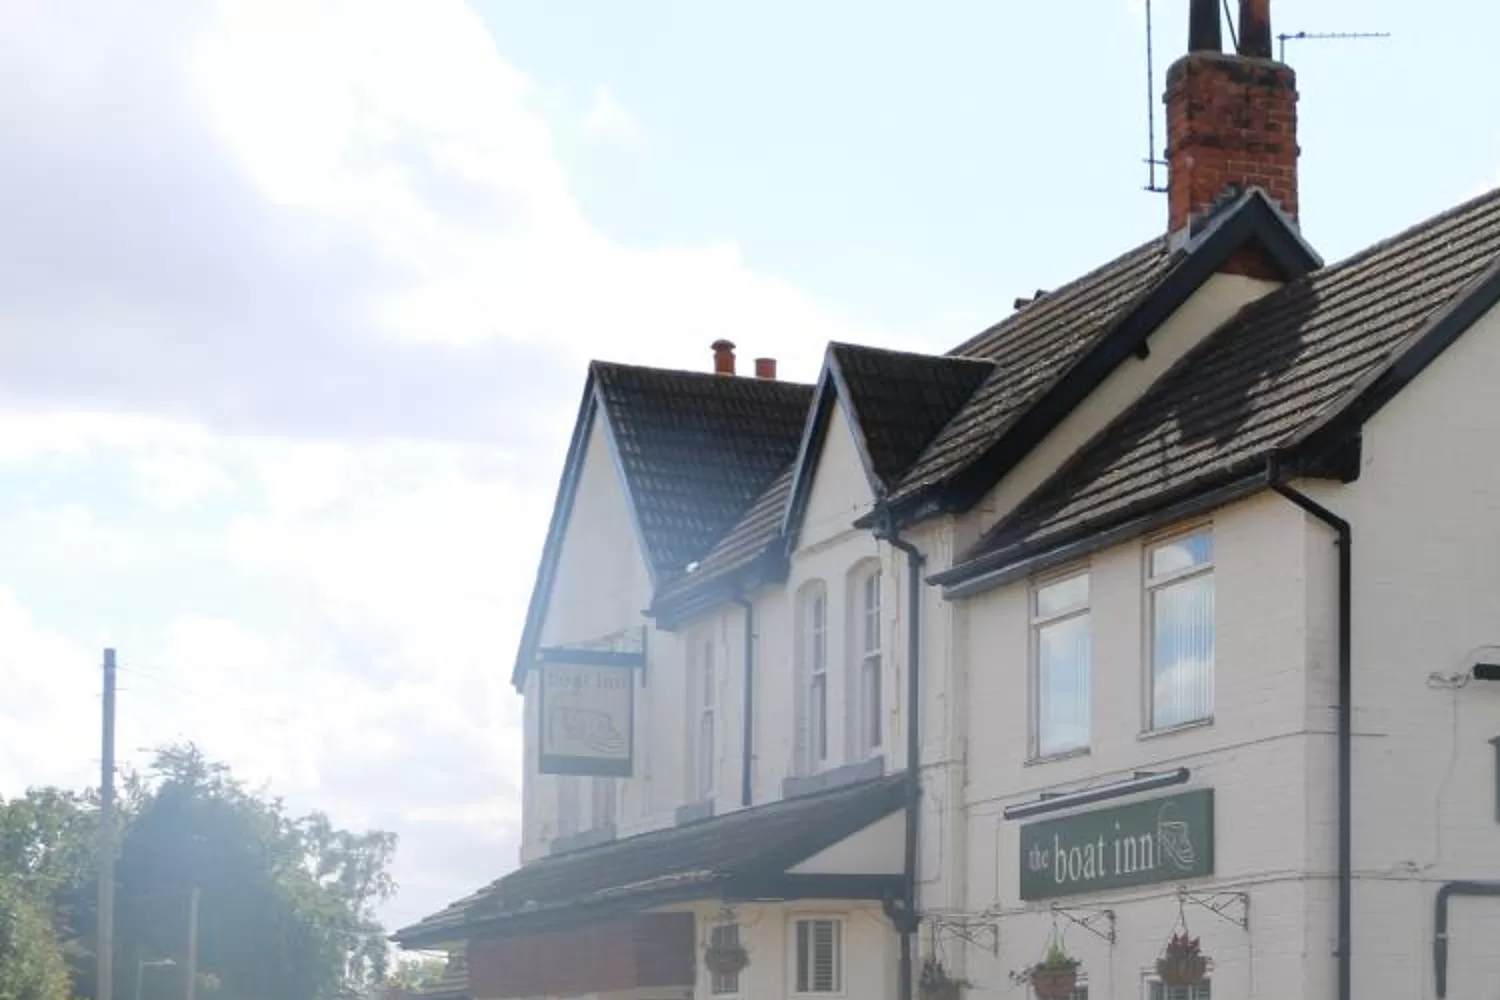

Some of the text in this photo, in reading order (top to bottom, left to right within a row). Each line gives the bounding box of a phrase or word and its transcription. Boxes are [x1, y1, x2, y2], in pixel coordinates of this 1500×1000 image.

[1029, 818, 1154, 884] the boat inn
